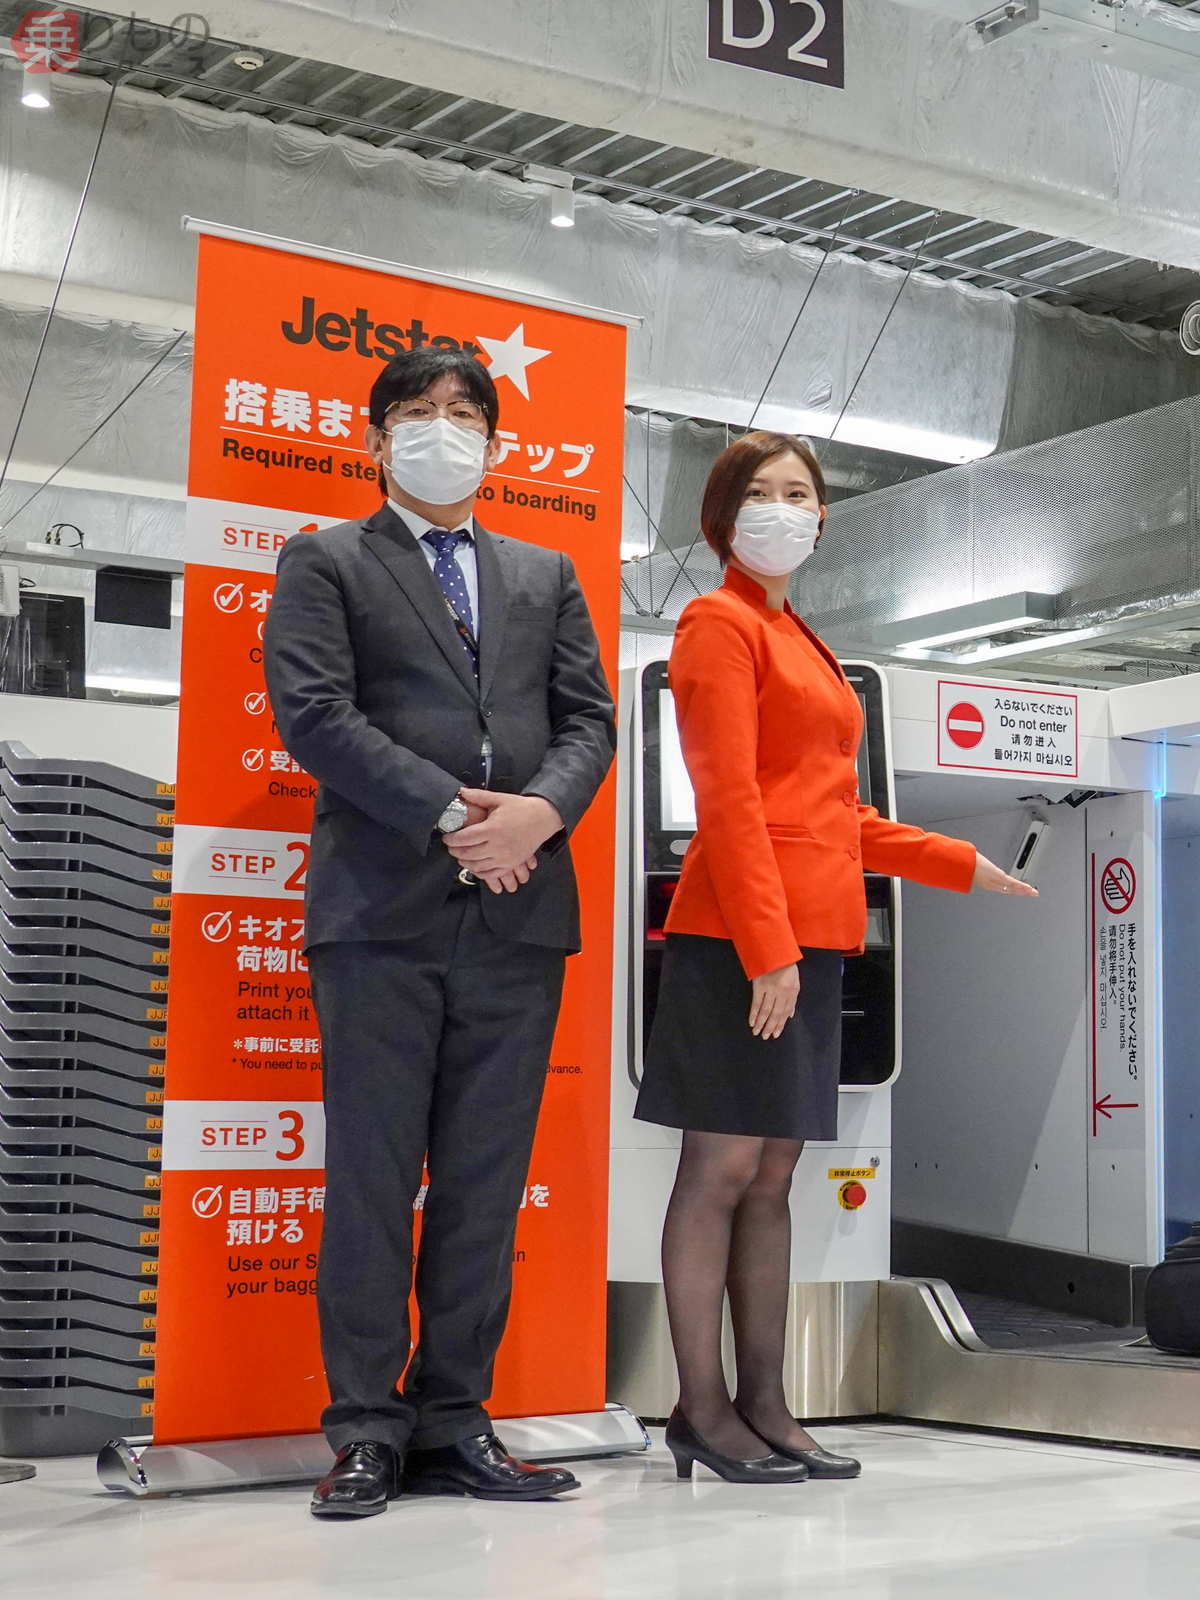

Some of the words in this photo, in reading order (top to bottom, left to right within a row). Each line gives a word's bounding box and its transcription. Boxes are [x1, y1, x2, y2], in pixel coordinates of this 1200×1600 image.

[721, 0, 829, 68] D2
[225, 378, 369, 439] 搭乗ま
[222, 438, 333, 474] Required
[503, 486, 596, 521] boarding
[223, 527, 287, 550] STEP
[994, 698, 1073, 716] 入らないでください
[1000, 716, 1015, 728] Do
[1019, 719, 1036, 730] not
[1040, 720, 1067, 733] enter
[994, 748, 1032, 763] 들어가지
[1036, 752, 1073, 767] 마십시오
[268, 781, 317, 799] Check
[211, 853, 276, 874] STEP
[284, 841, 311, 891] 2
[238, 981, 279, 998] Print
[237, 1005, 291, 1020] attach
[298, 1006, 309, 1020] it
[265, 1058, 292, 1070] need
[296, 1059, 307, 1070] to
[202, 1127, 267, 1146] STEP
[276, 1110, 305, 1161] 3
[229, 1186, 326, 1214] 自動手荷
[226, 1218, 304, 1246] 預ける
[228, 1256, 263, 1272] Use
[269, 1256, 300, 1270] our
[226, 1281, 268, 1298] your
